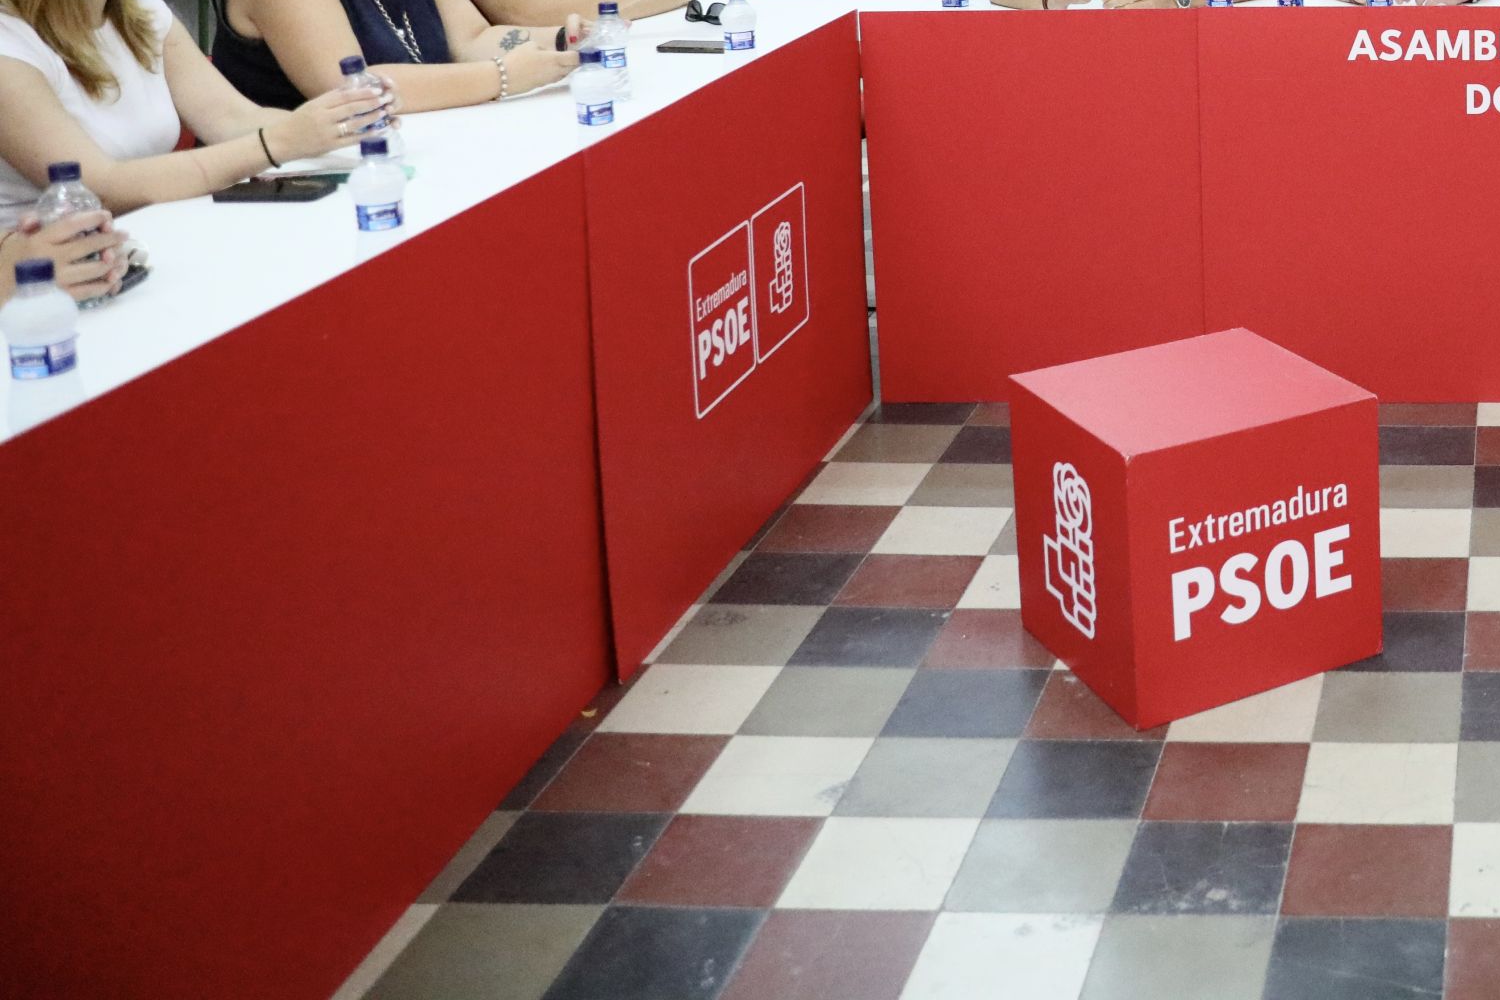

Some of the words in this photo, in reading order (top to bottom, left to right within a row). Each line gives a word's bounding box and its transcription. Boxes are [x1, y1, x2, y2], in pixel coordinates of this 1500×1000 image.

[696, 269, 748, 322] Extremadura
[698, 295, 750, 381] PSOE
[1168, 482, 1348, 554] Extremadura
[1171, 523, 1352, 642] PSOE
